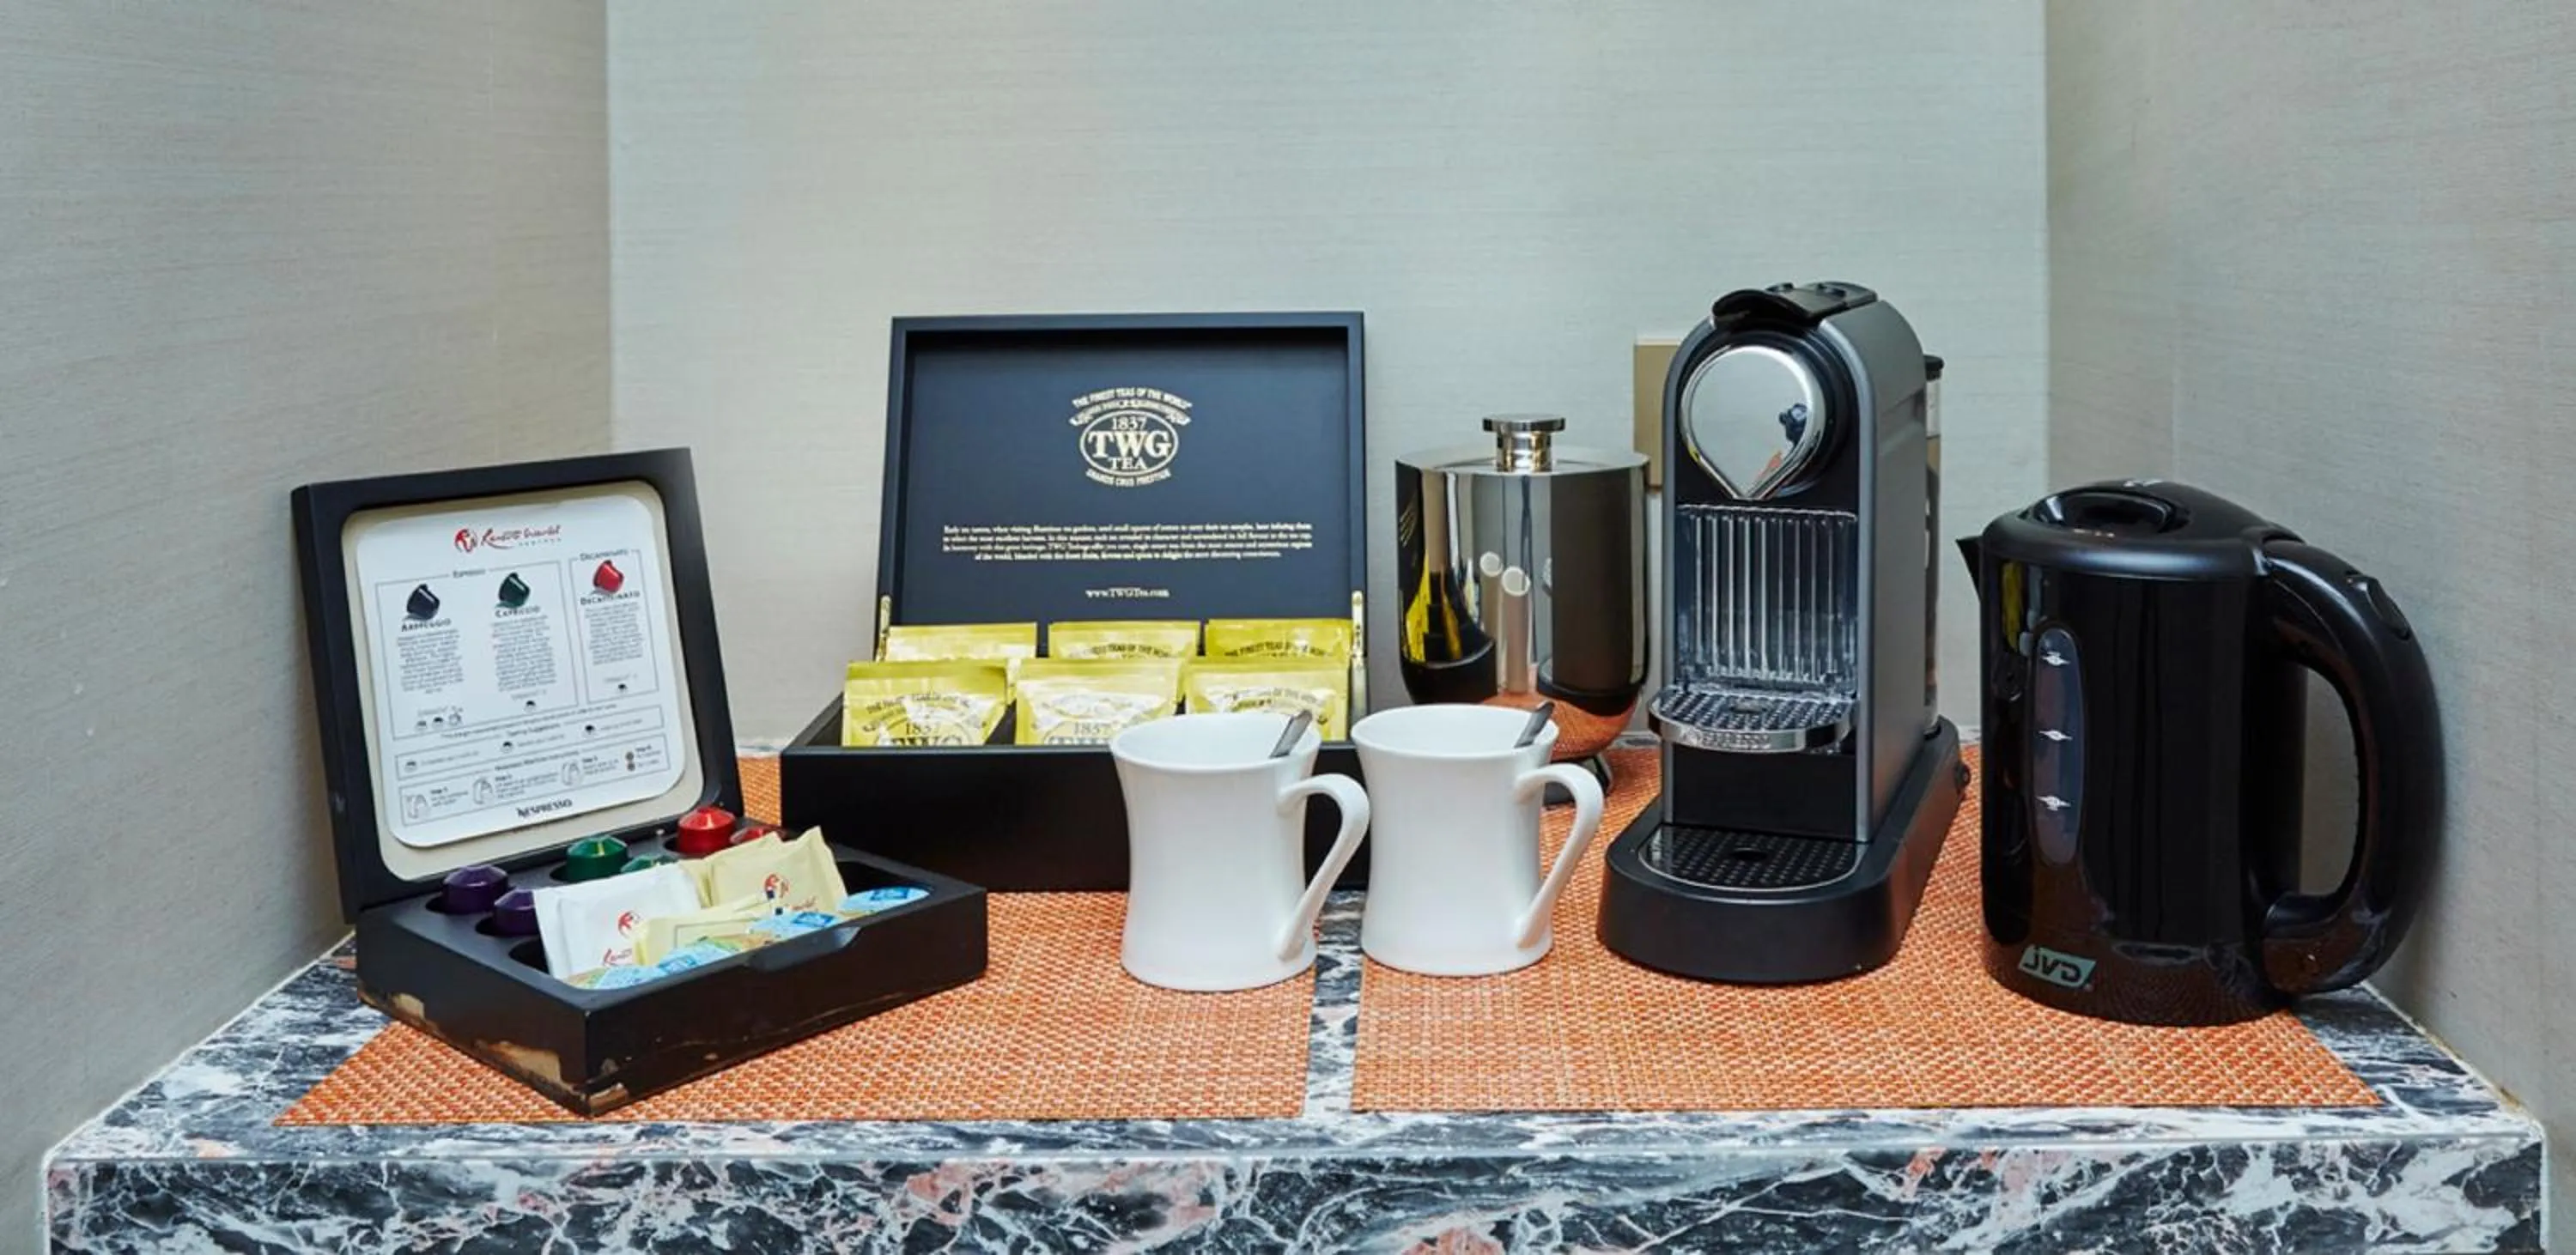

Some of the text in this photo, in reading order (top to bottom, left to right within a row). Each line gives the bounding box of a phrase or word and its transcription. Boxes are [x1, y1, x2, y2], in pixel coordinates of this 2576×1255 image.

[1112, 417, 1148, 430] 1837
[1087, 430, 1172, 458] TWG
[1108, 457, 1148, 470] TEA
